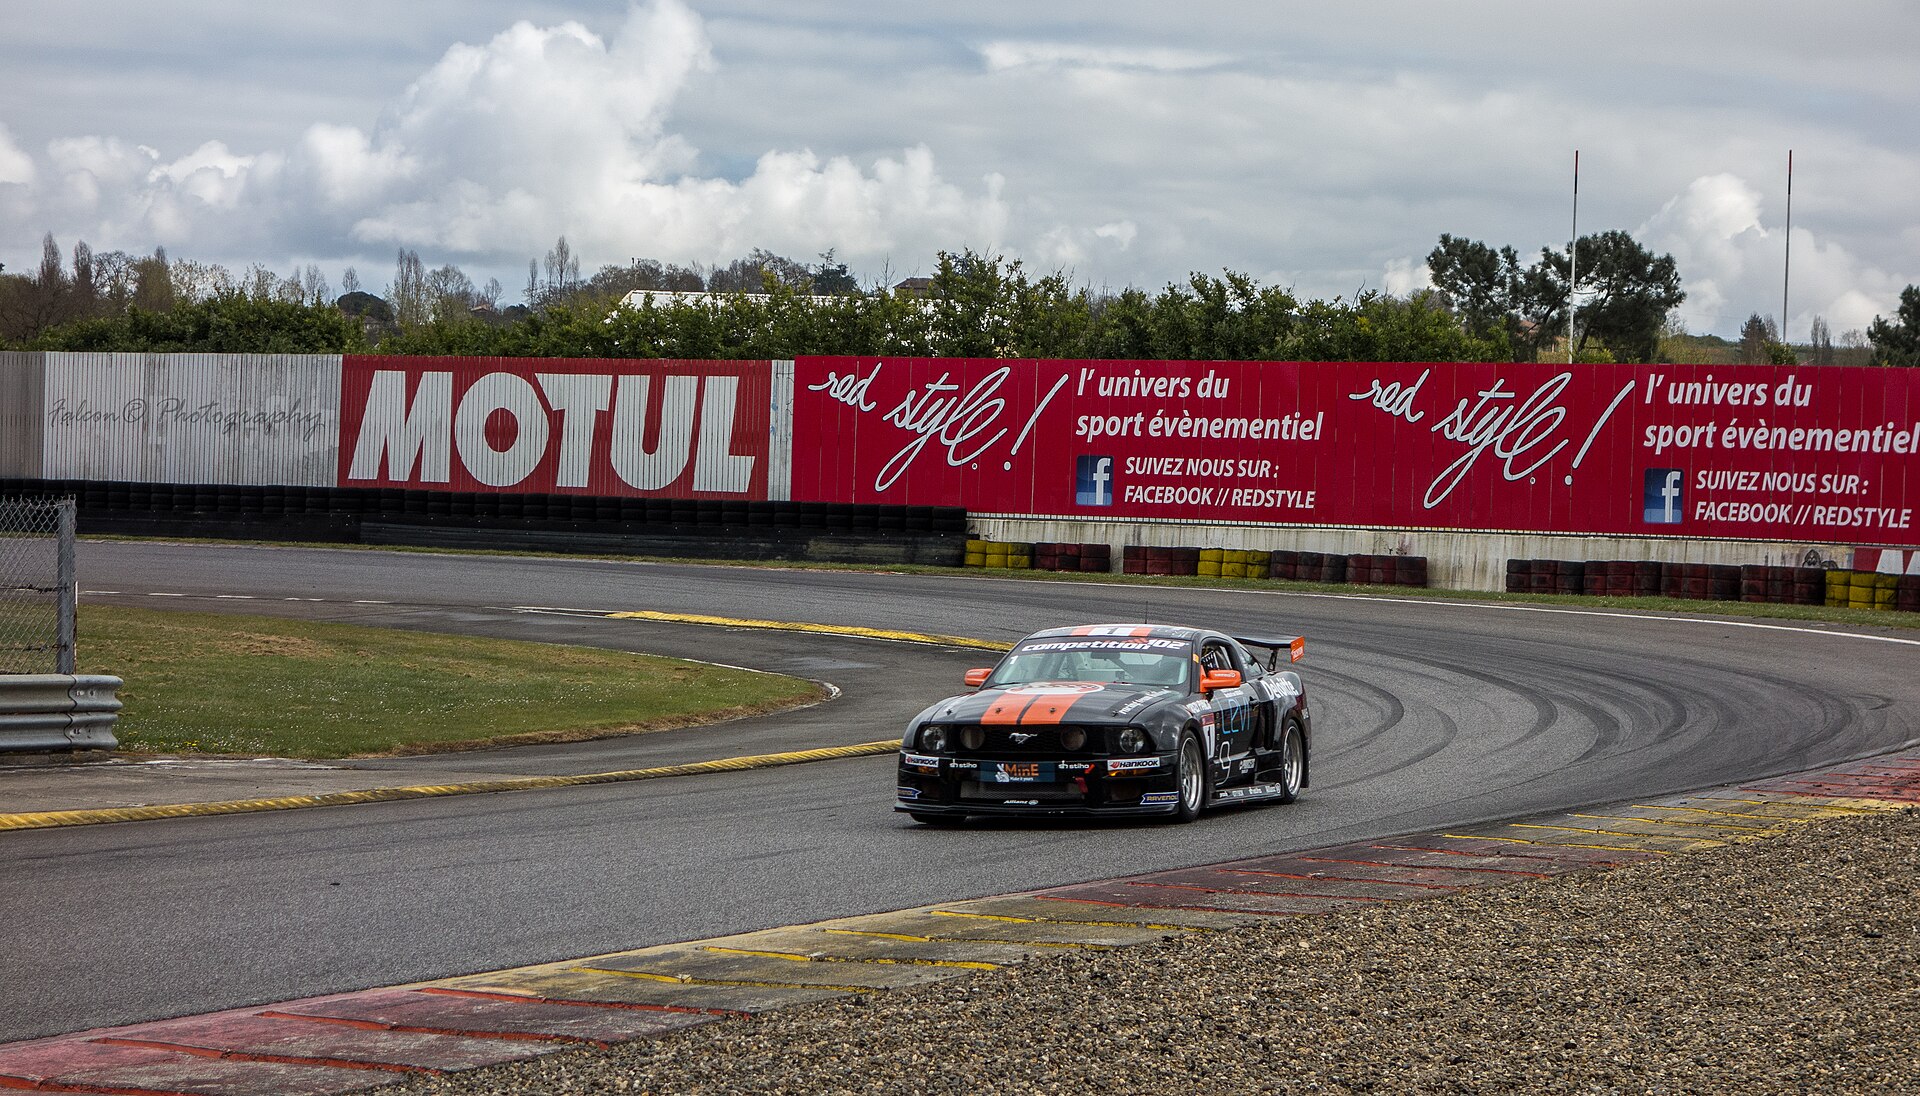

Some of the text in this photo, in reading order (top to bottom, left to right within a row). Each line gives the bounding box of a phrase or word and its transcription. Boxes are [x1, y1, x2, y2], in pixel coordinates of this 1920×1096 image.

[808, 362, 882, 412] red
[1098, 369, 1191, 398] univers
[1196, 369, 1230, 398] du
[1348, 368, 1430, 422] red
[1667, 374, 1768, 406] univers
[1774, 375, 1812, 407] du
[347, 370, 756, 493] MOTUL
[1075, 408, 1324, 443] sport évènementiel
[1643, 418, 1920, 455] sport évènementiel
[1125, 456, 1184, 476] SUIVEZ
[1186, 458, 1234, 478] NOUS
[1237, 460, 1270, 478] SUR
[1695, 469, 1758, 492] SUIVEZ
[1761, 472, 1816, 494] NOUS
[1819, 474, 1858, 495] SUR
[1124, 485, 1213, 506] FACEBOOK
[1231, 490, 1316, 509] REDSTYLE
[1694, 501, 1792, 524] FACEBOOK
[1813, 507, 1913, 529] REDSTYLE
